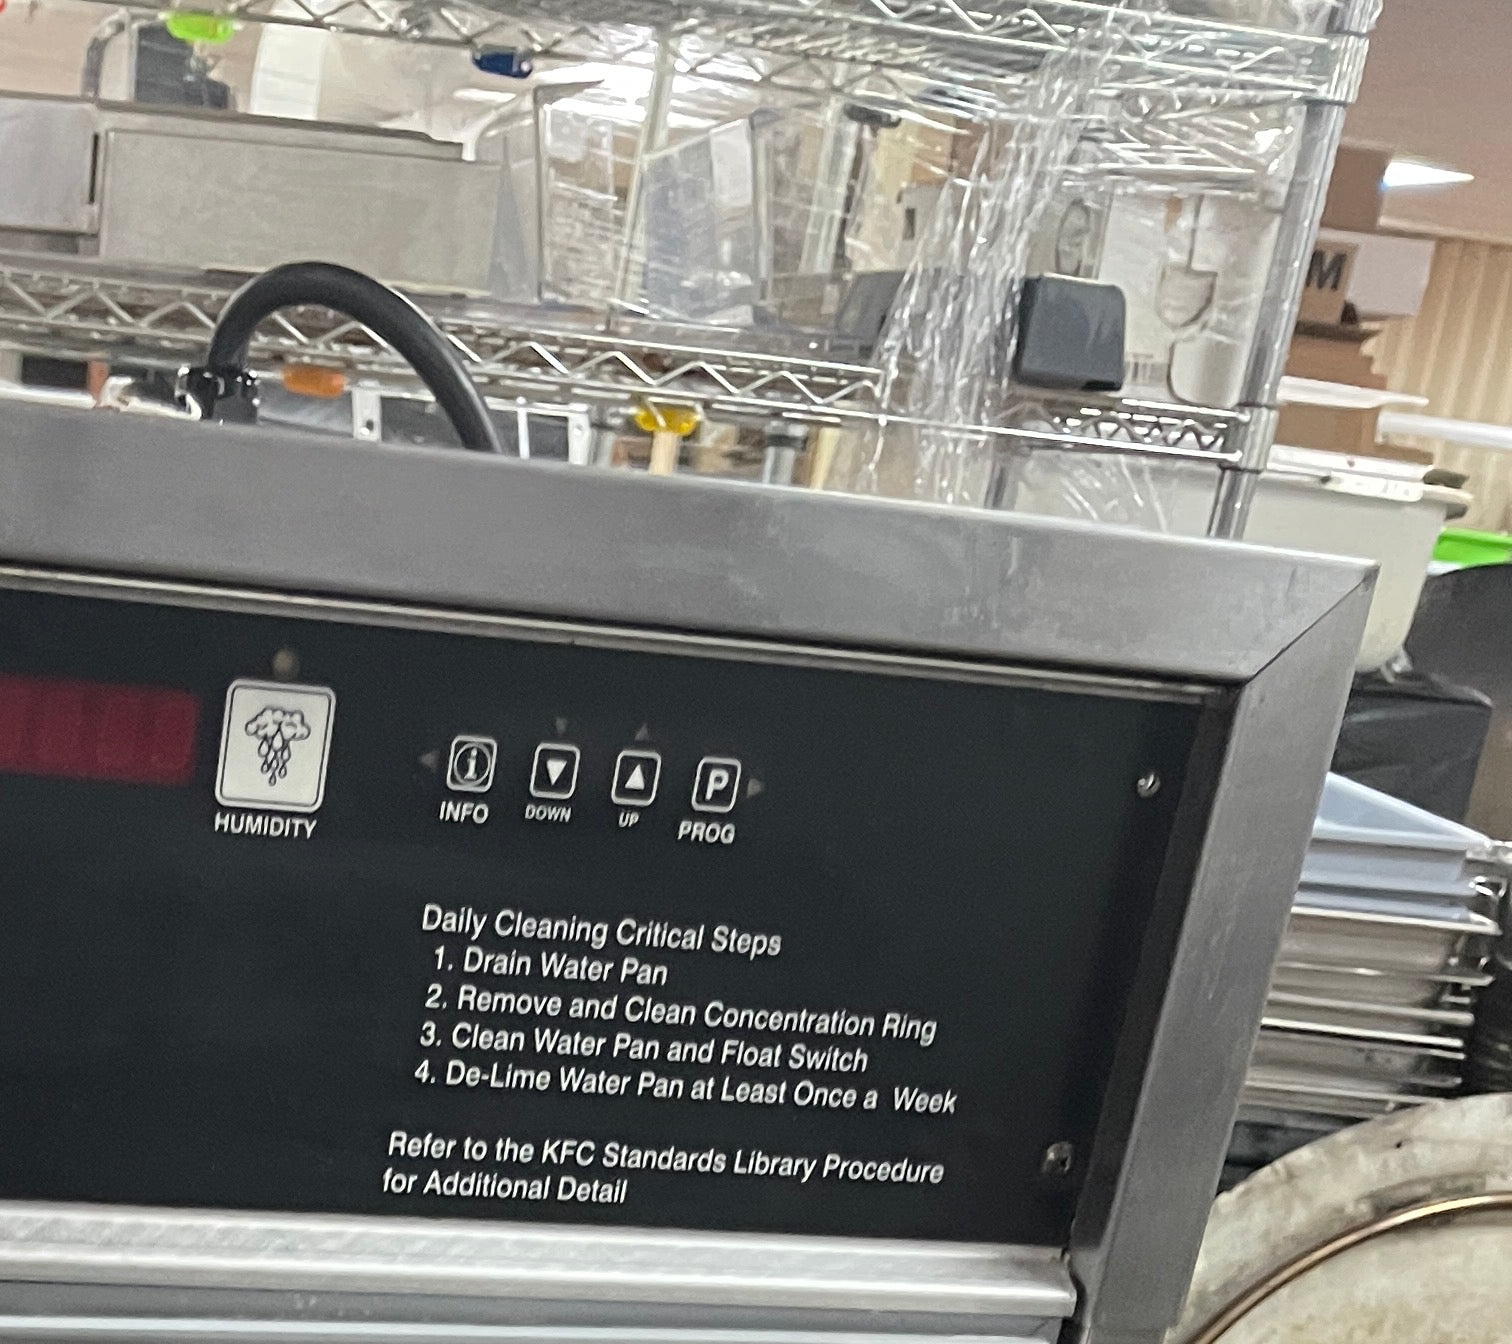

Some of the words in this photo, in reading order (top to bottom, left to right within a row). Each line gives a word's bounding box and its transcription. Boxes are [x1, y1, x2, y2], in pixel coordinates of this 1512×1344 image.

[214, 811, 318, 840] HUMIDITY
[439, 800, 489, 825] INFO
[524, 803, 572, 823] DOWN
[618, 811, 640, 828] UP
[677, 820, 736, 845] PROG
[422, 903, 487, 941] Daily
[495, 909, 609, 950] Cleaning
[616, 918, 705, 950] Critical
[711, 925, 782, 961] Steps
[434, 945, 454, 971] 1.
[463, 946, 531, 976] Drain
[541, 952, 614, 982] Water
[620, 956, 668, 986] Pan
[425, 983, 447, 1009] 2.
[458, 984, 561, 1016] Remove
[569, 995, 618, 1020] and
[624, 996, 696, 1026] Clean
[704, 1000, 875, 1037] Concentration
[882, 1012, 937, 1047] Ring
[419, 1021, 442, 1047] 3.
[451, 1022, 525, 1051] Clean
[535, 1027, 607, 1056] Water
[613, 1033, 660, 1060] Pan
[666, 1039, 715, 1064] and
[721, 1039, 783, 1068] Float
[788, 1043, 869, 1073] Switch
[414, 1059, 436, 1084] 4.
[445, 1060, 551, 1091] De-Lime
[559, 1066, 631, 1095] Water
[637, 1071, 684, 1099] Pan
[690, 1077, 715, 1101] at
[721, 1076, 787, 1104] Least
[793, 1080, 857, 1109] Once
[863, 1089, 878, 1110] a
[892, 1086, 958, 1115] Week
[388, 1131, 456, 1159] Refer
[463, 1137, 488, 1161] to
[495, 1138, 534, 1163] the
[541, 1139, 595, 1167] KFC
[602, 1142, 727, 1173] Standards
[733, 1149, 817, 1184] Library
[822, 1153, 945, 1184] Procedure
[382, 1167, 418, 1193] for
[423, 1170, 551, 1200] Additional
[557, 1175, 628, 1204] Detail
